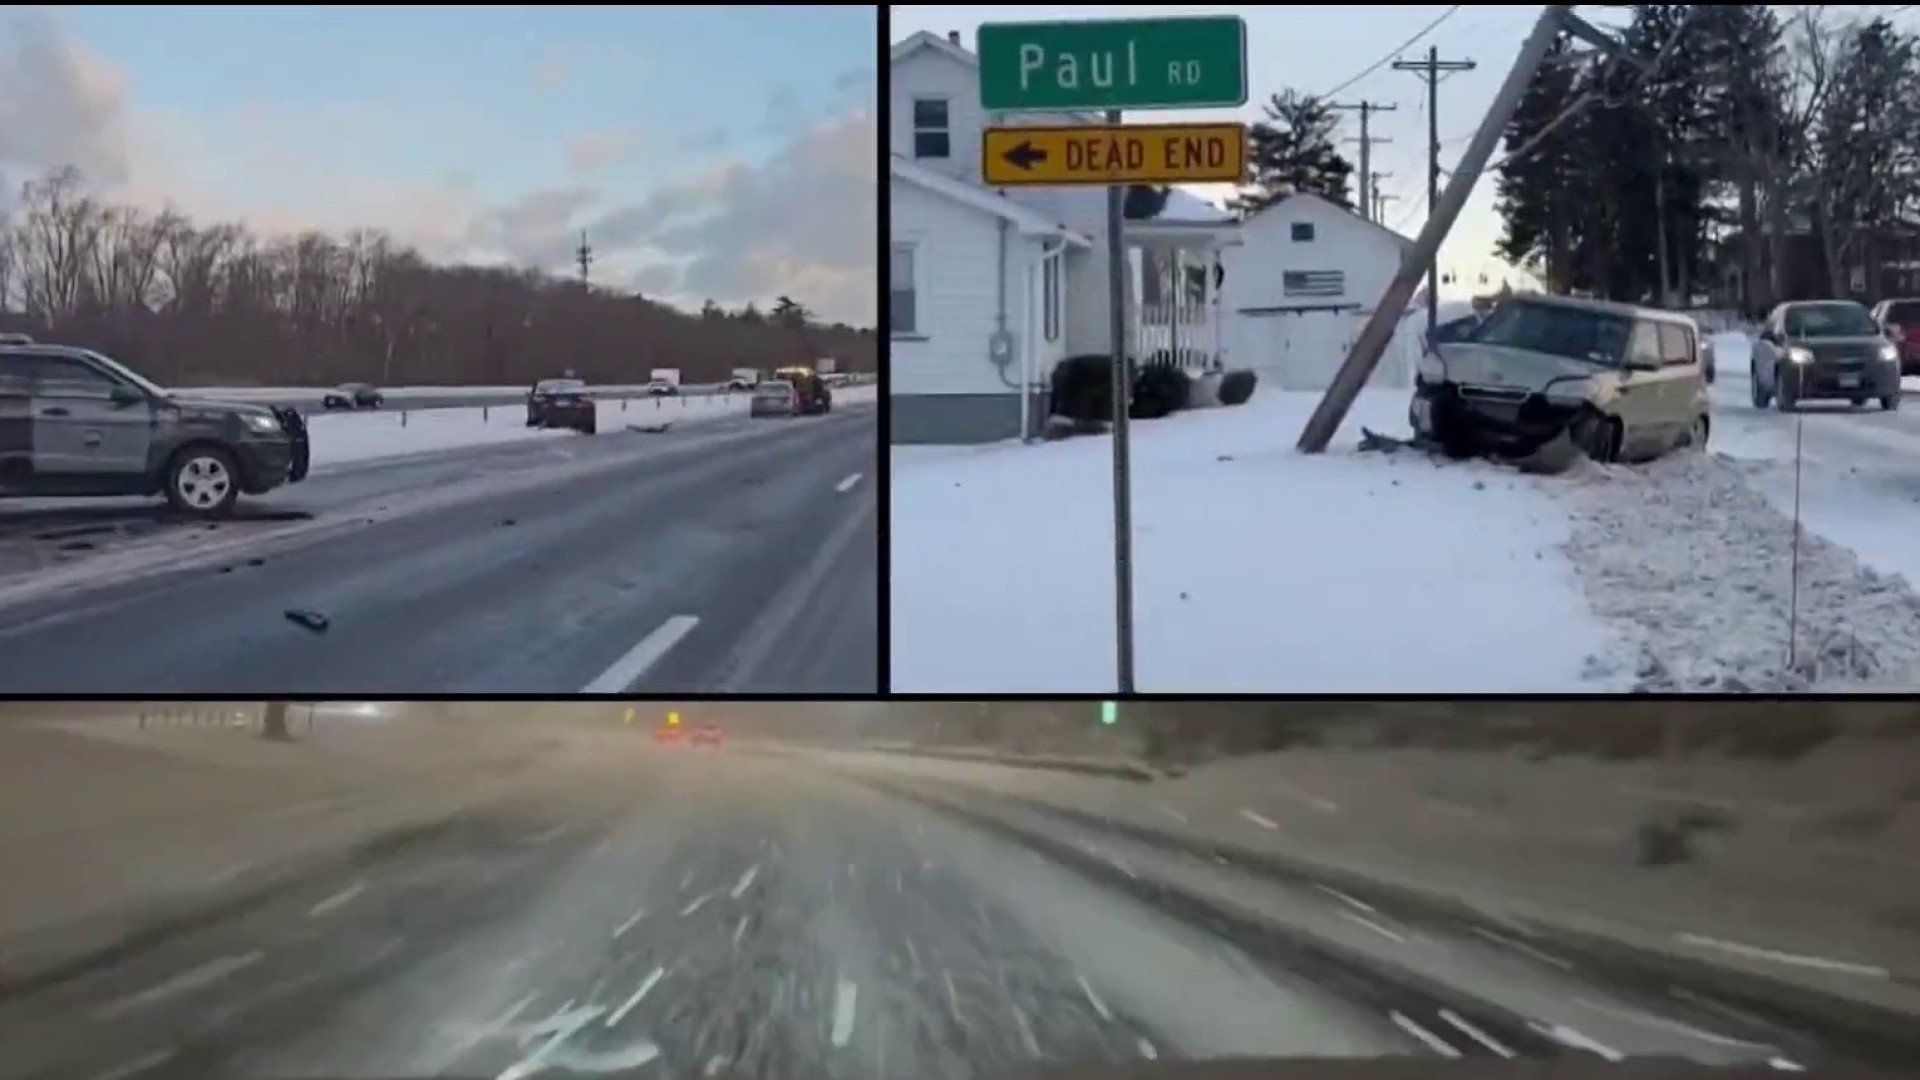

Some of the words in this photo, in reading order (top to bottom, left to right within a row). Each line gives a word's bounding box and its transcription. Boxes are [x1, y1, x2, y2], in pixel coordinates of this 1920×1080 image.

[1020, 40, 1136, 90] Paul
[1168, 60, 1201, 85] RD
[1066, 137, 1144, 171] DEAD
[1164, 136, 1225, 170] END
